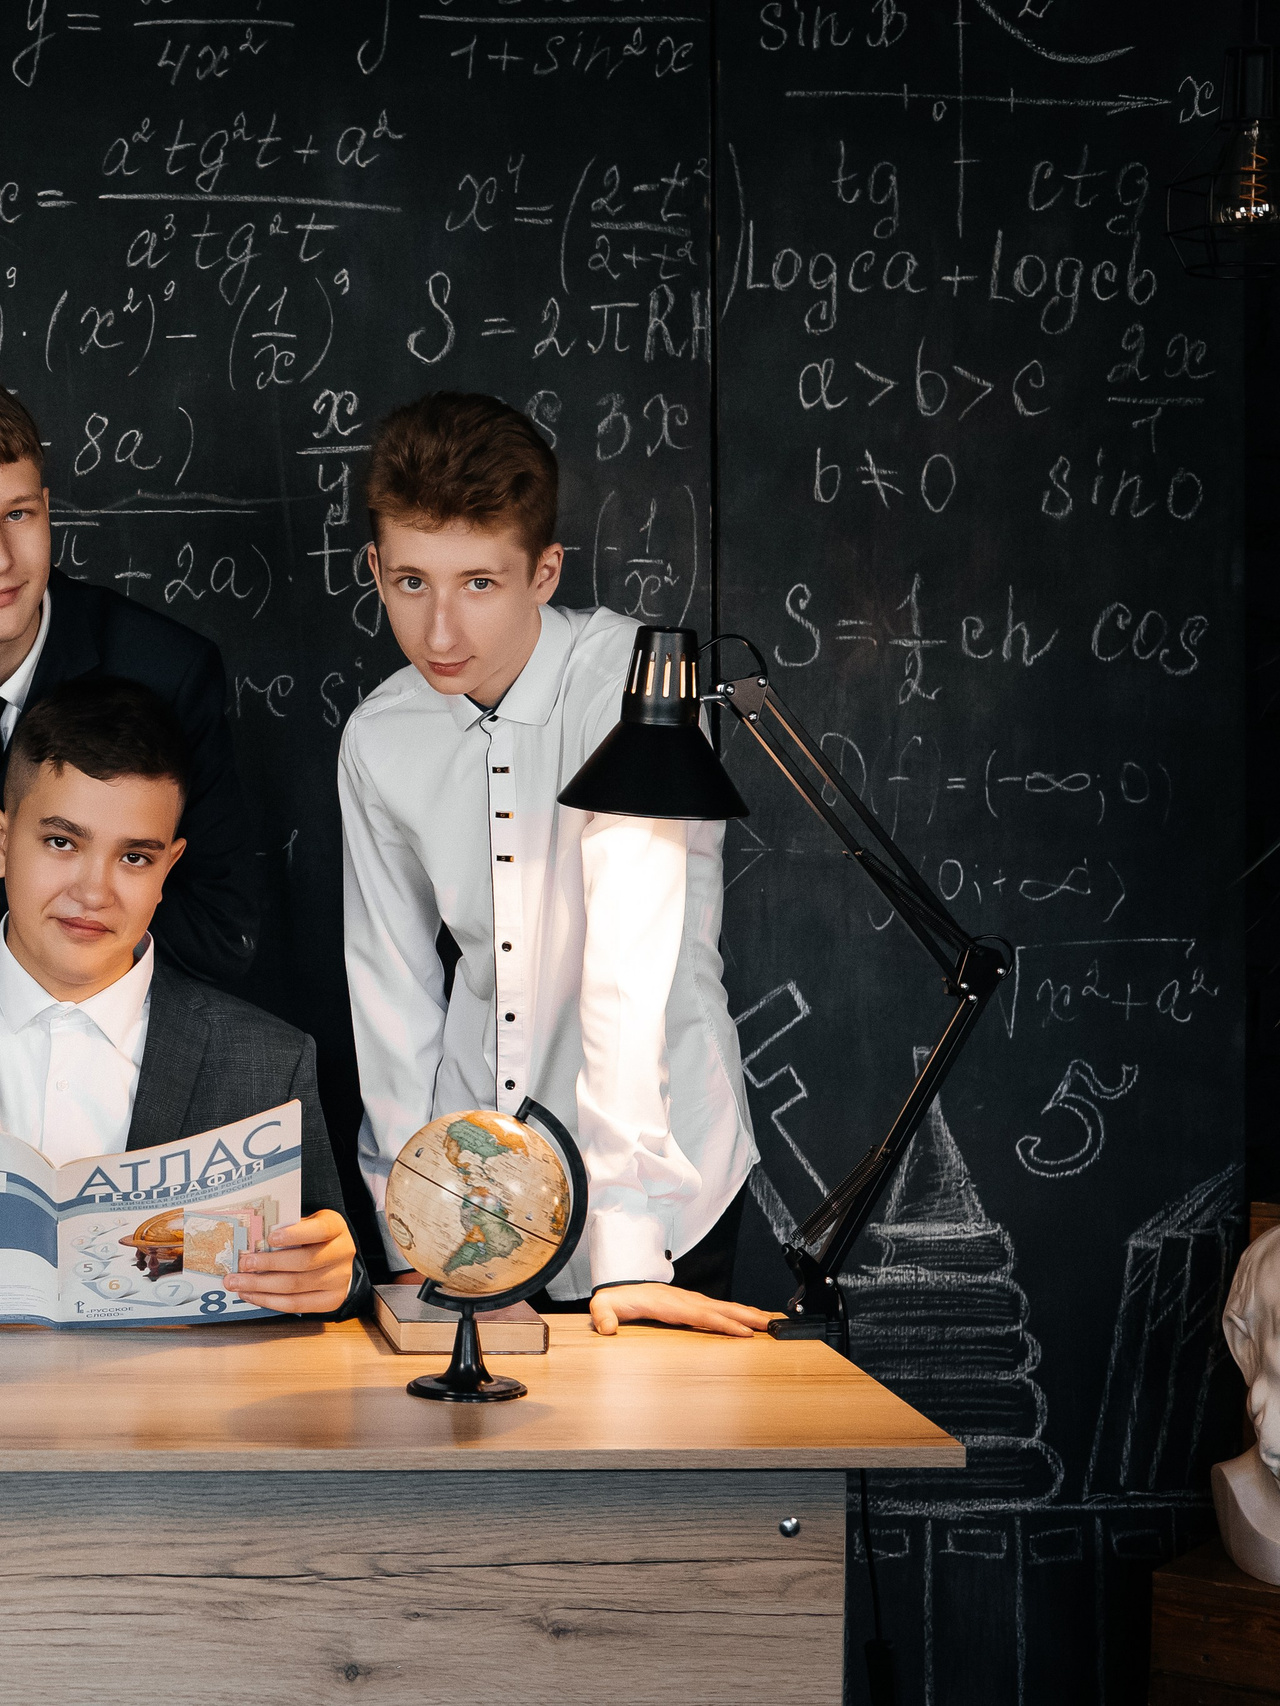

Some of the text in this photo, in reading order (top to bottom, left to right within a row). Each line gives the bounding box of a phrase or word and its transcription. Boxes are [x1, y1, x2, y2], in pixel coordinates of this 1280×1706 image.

[75, 1120, 282, 1198] АТЛАС
[94, 1159, 265, 1204] ГЕОГРАФИЯ
[220, 1174, 253, 1190] РОССИИ
[220, 1180, 254, 1196] РОССИИ
[83, 1263, 93, 1273] 5
[108, 1279, 121, 1290] 6
[168, 1285, 181, 1297] 7
